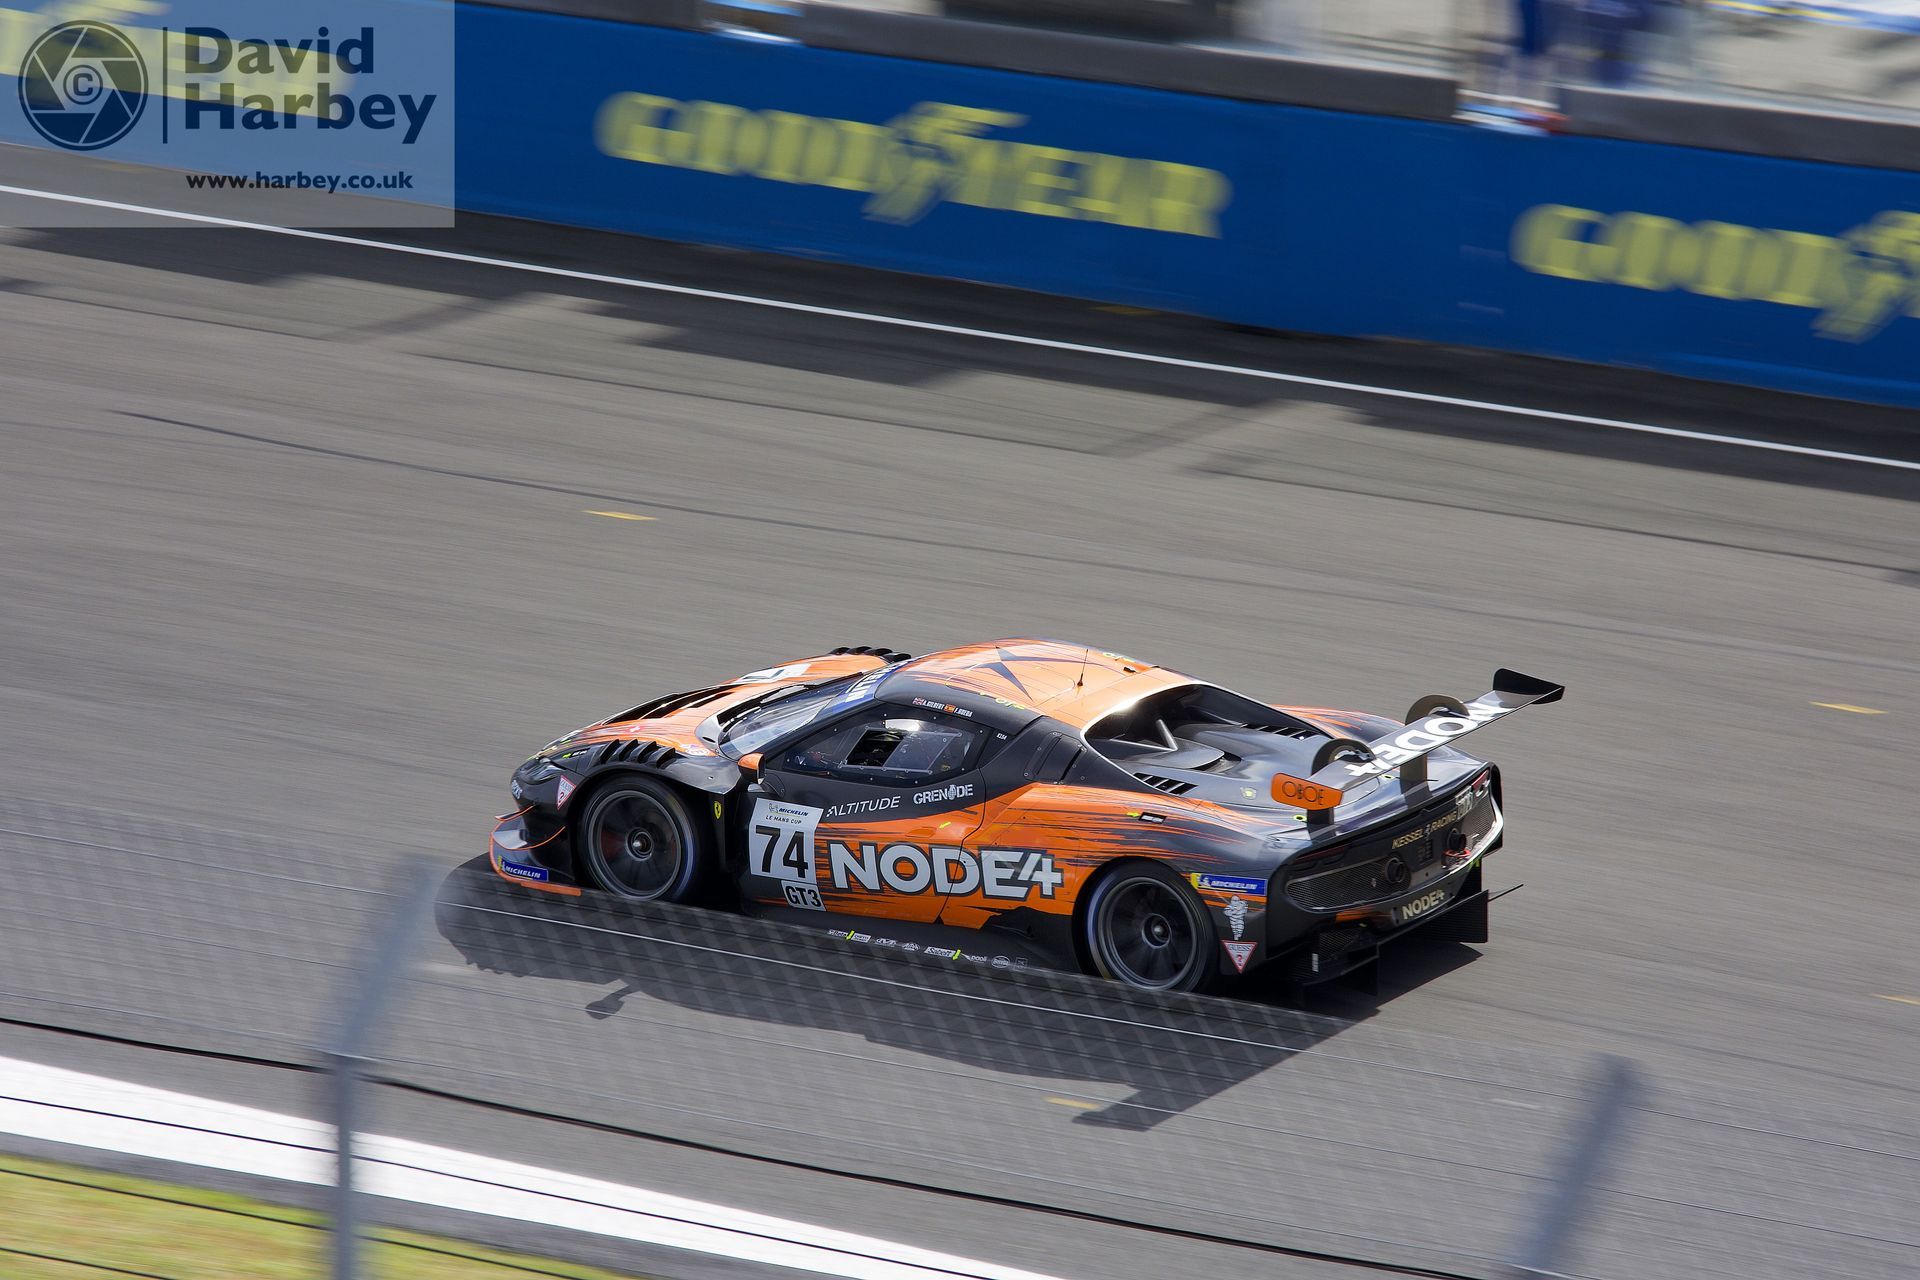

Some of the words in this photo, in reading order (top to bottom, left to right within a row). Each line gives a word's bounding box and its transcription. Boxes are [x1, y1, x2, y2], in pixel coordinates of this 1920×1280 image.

[779, 807, 808, 816] MICHELIN
[826, 796, 901, 818] ALTITUDE
[1429, 811, 1457, 833] RACING
[756, 825, 808, 878] 74
[505, 866, 541, 879] MICHELIN
[827, 842, 1064, 899] NODE4
[1211, 880, 1258, 890] MICHELIN
[785, 885, 822, 908] GT3
[1402, 889, 1445, 920] NODE4
